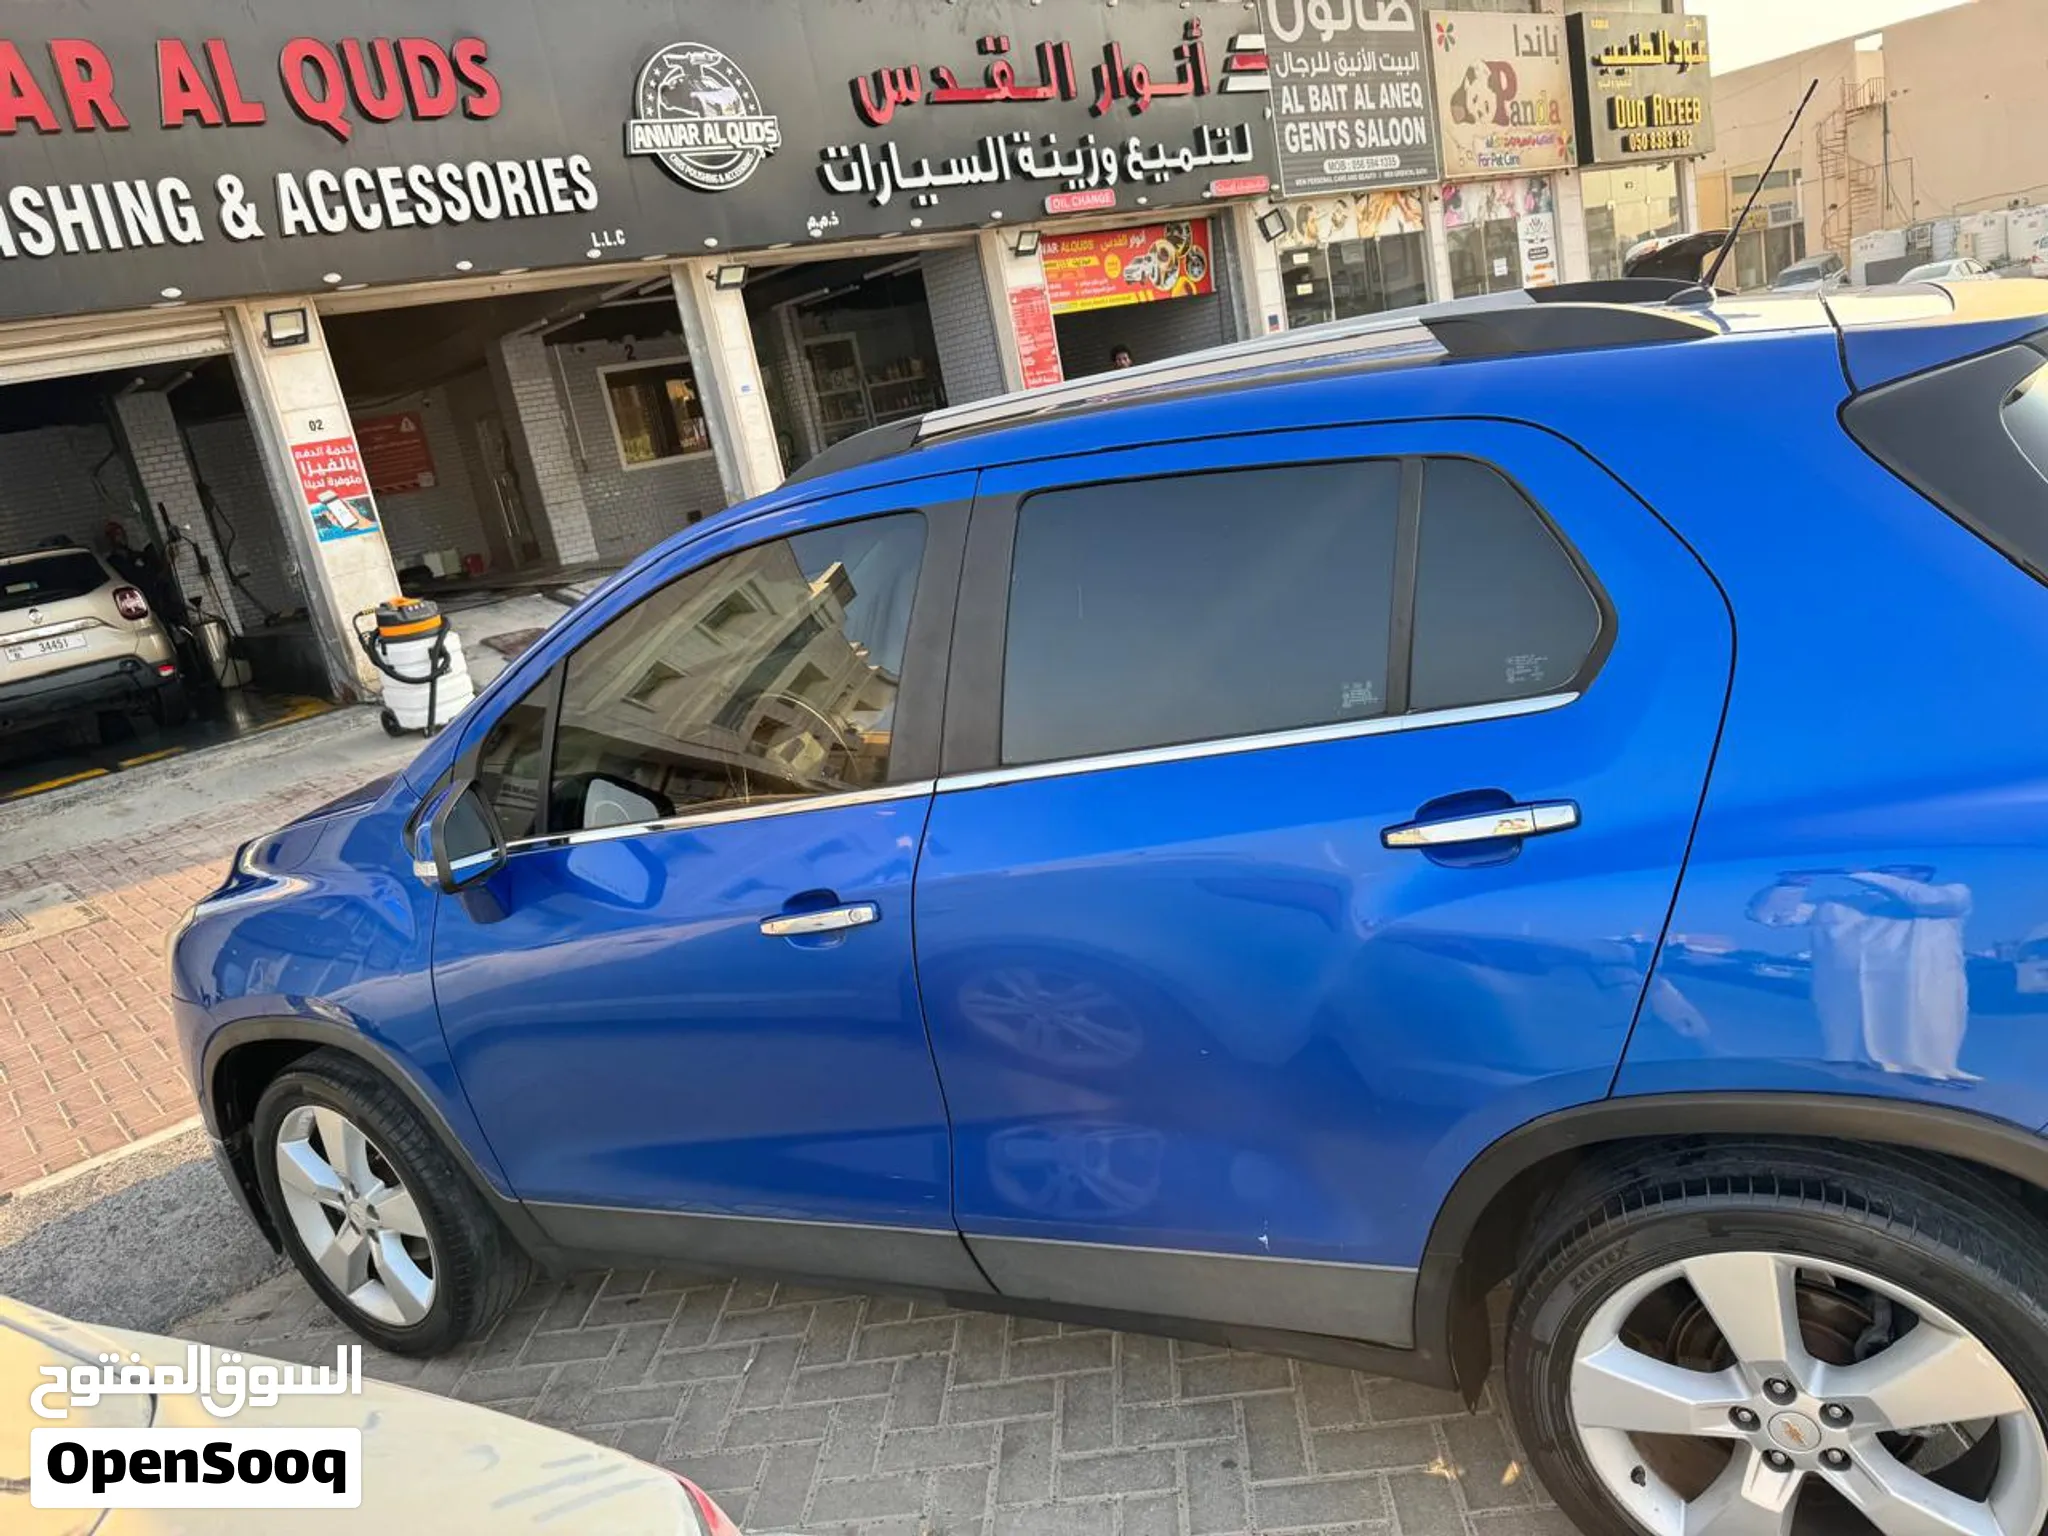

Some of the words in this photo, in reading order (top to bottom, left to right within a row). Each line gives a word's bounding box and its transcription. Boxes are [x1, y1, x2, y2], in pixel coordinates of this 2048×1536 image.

[853, 34, 1077, 124] القدس
[1092, 17, 1210, 115] أنوار
[1275, 51, 1331, 78] للرجال
[1334, 48, 1377, 77] الأنيق
[1379, 51, 1420, 76] البيت
[157, 38, 267, 128] AL
[279, 36, 501, 141] QUDS
[1281, 84, 1305, 115] AL
[1307, 83, 1349, 112] BAIT
[1354, 83, 1376, 111] AL
[1379, 82, 1424, 110] ANEQ
[1484, 60, 1561, 127] Panda
[633, 122, 702, 149] ANWAR
[703, 122, 727, 145] AL
[726, 121, 779, 148] QUDS
[1284, 119, 1350, 153] GENTS
[1354, 116, 1427, 149] SALOON
[1016, 131, 1118, 191] وزينة
[1126, 122, 1253, 183] لتلميع
[821, 135, 1010, 206] السيارات
[214, 173, 266, 241] &
[276, 153, 599, 236] ACCESSORIES
[1052, 197, 1070, 210] OIL
[1071, 193, 1112, 207] CHANGE
[591, 229, 626, 248] L.L.C
[308, 419, 324, 432] 02
[300, 456, 359, 478] بالفيزا
